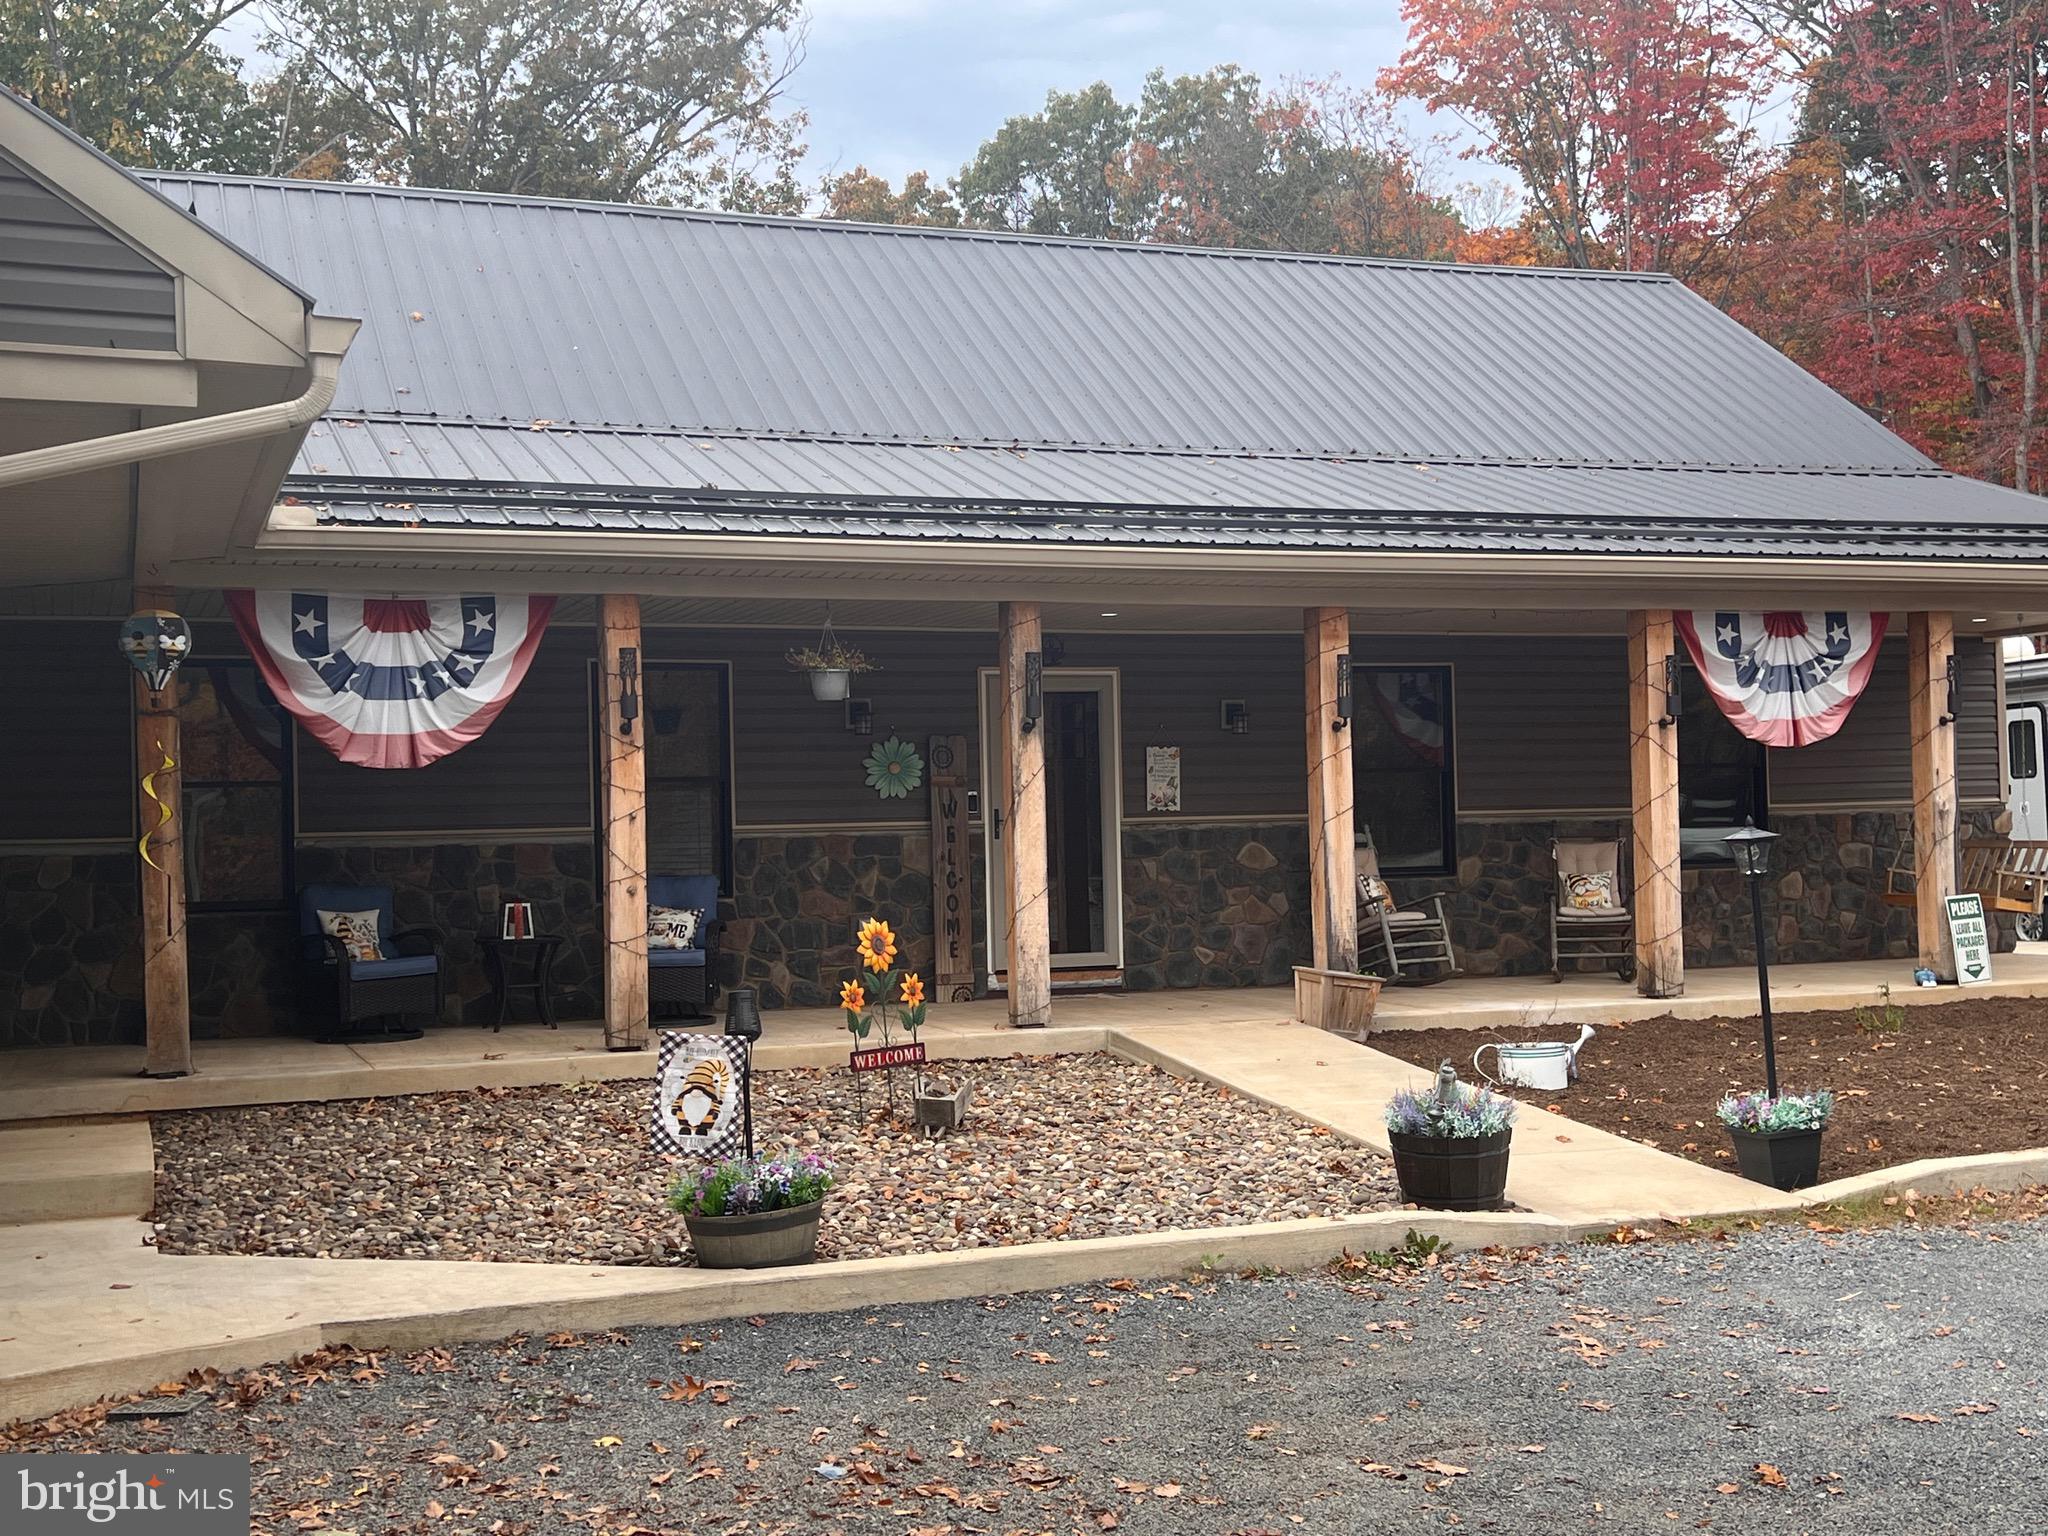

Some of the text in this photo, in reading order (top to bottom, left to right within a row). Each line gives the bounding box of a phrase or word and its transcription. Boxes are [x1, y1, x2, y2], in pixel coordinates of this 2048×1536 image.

[942, 797, 960, 959] WELCOME
[1950, 900, 1980, 917] PLEASE
[1954, 921, 1983, 935] LEAVE ALL
[1956, 935, 1985, 949] PACKAGES
[1965, 949, 1981, 961] HERE
[854, 1046, 924, 1069] WELCOME
